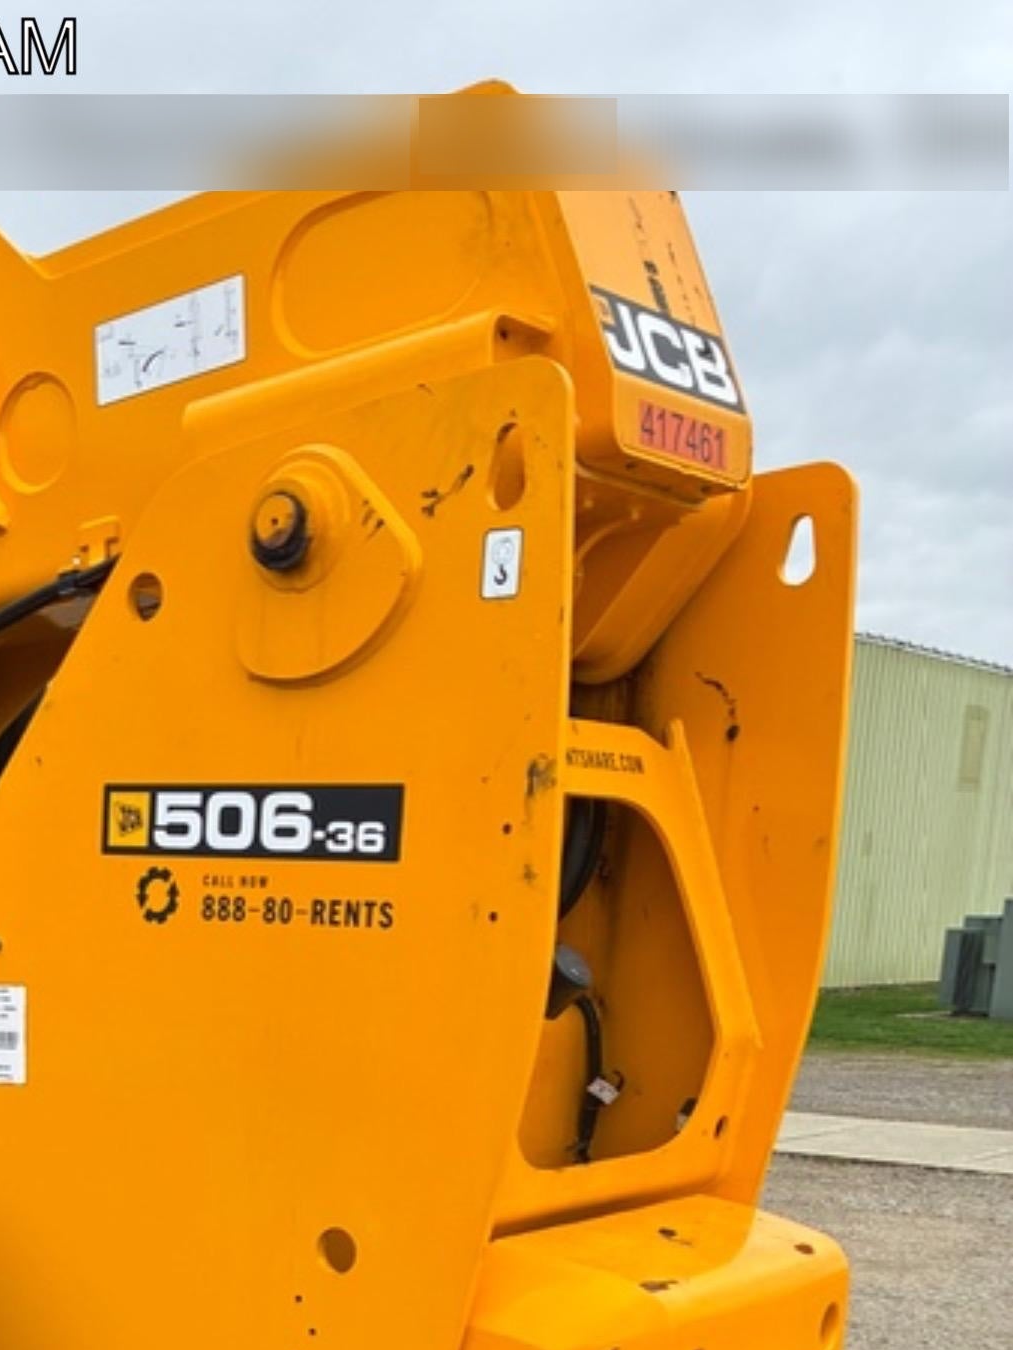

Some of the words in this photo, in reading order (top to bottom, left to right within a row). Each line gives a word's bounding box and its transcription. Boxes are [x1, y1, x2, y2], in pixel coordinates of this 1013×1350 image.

[604, 301, 738, 405] JCB
[640, 404, 724, 471] 417461
[152, 791, 385, 853] 506-36
[201, 895, 394, 929] 888-80-RENTS
[202, 874, 234, 888] CALL
[240, 875, 269, 889] NOW
